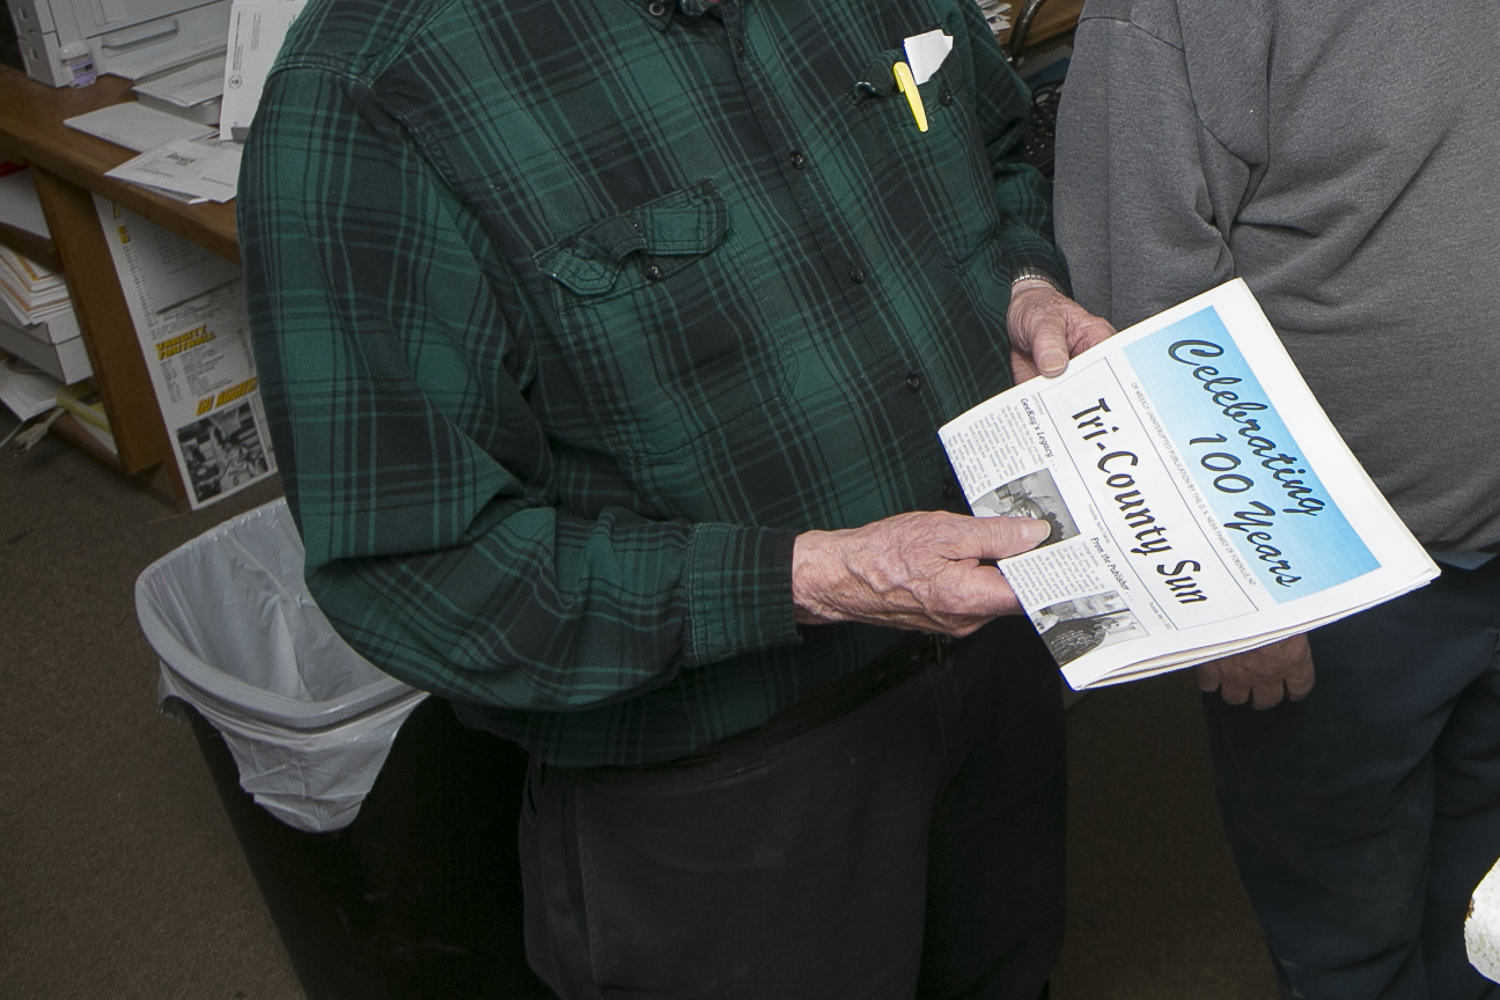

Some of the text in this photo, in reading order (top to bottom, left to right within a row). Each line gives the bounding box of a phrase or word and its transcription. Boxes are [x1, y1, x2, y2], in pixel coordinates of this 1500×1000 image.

[1034, 430, 1055, 459] Legacy
[1072, 397, 1207, 603] Tri-County Sun
[1168, 339, 1325, 516] Celebrating
[1089, 535, 1132, 592] From the Publisher
[1189, 433, 1301, 586] 100 Years
